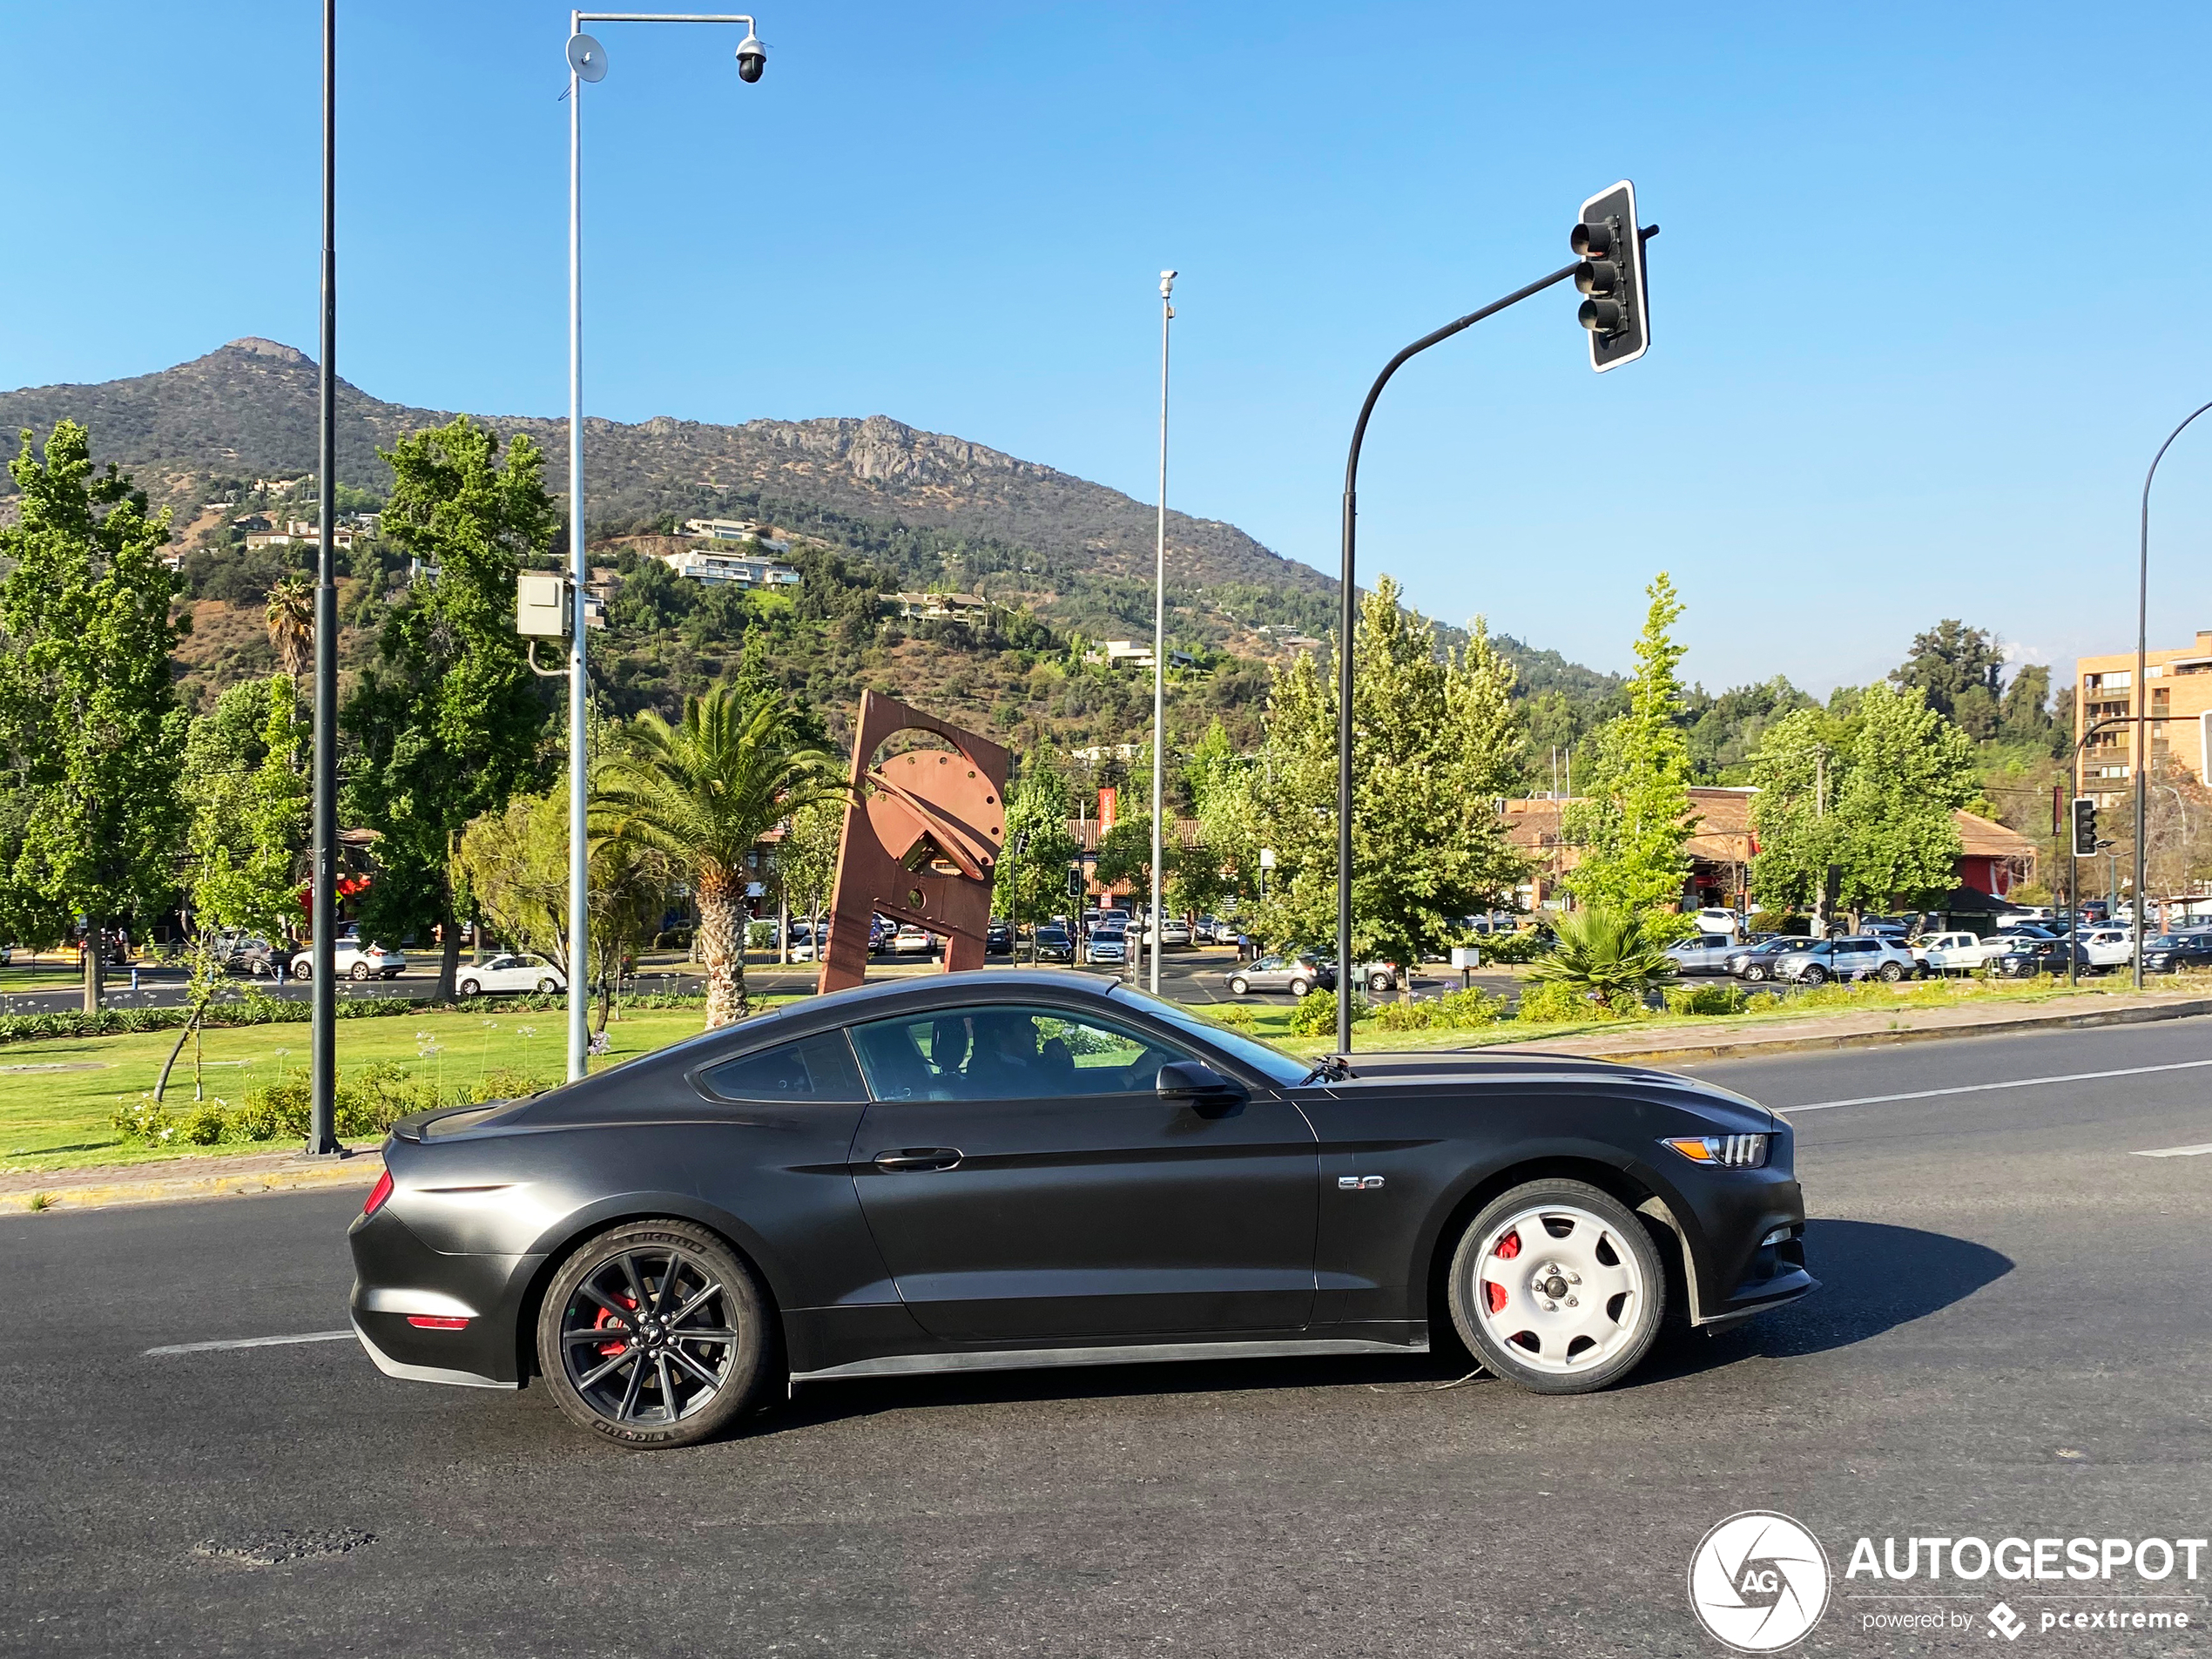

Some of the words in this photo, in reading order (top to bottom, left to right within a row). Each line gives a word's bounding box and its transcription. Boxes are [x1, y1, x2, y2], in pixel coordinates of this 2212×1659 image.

[1339, 1176, 1385, 1190] 5.0
[632, 1233, 704, 1253] MICHELIN
[594, 1421, 666, 1442] MICHELIN
